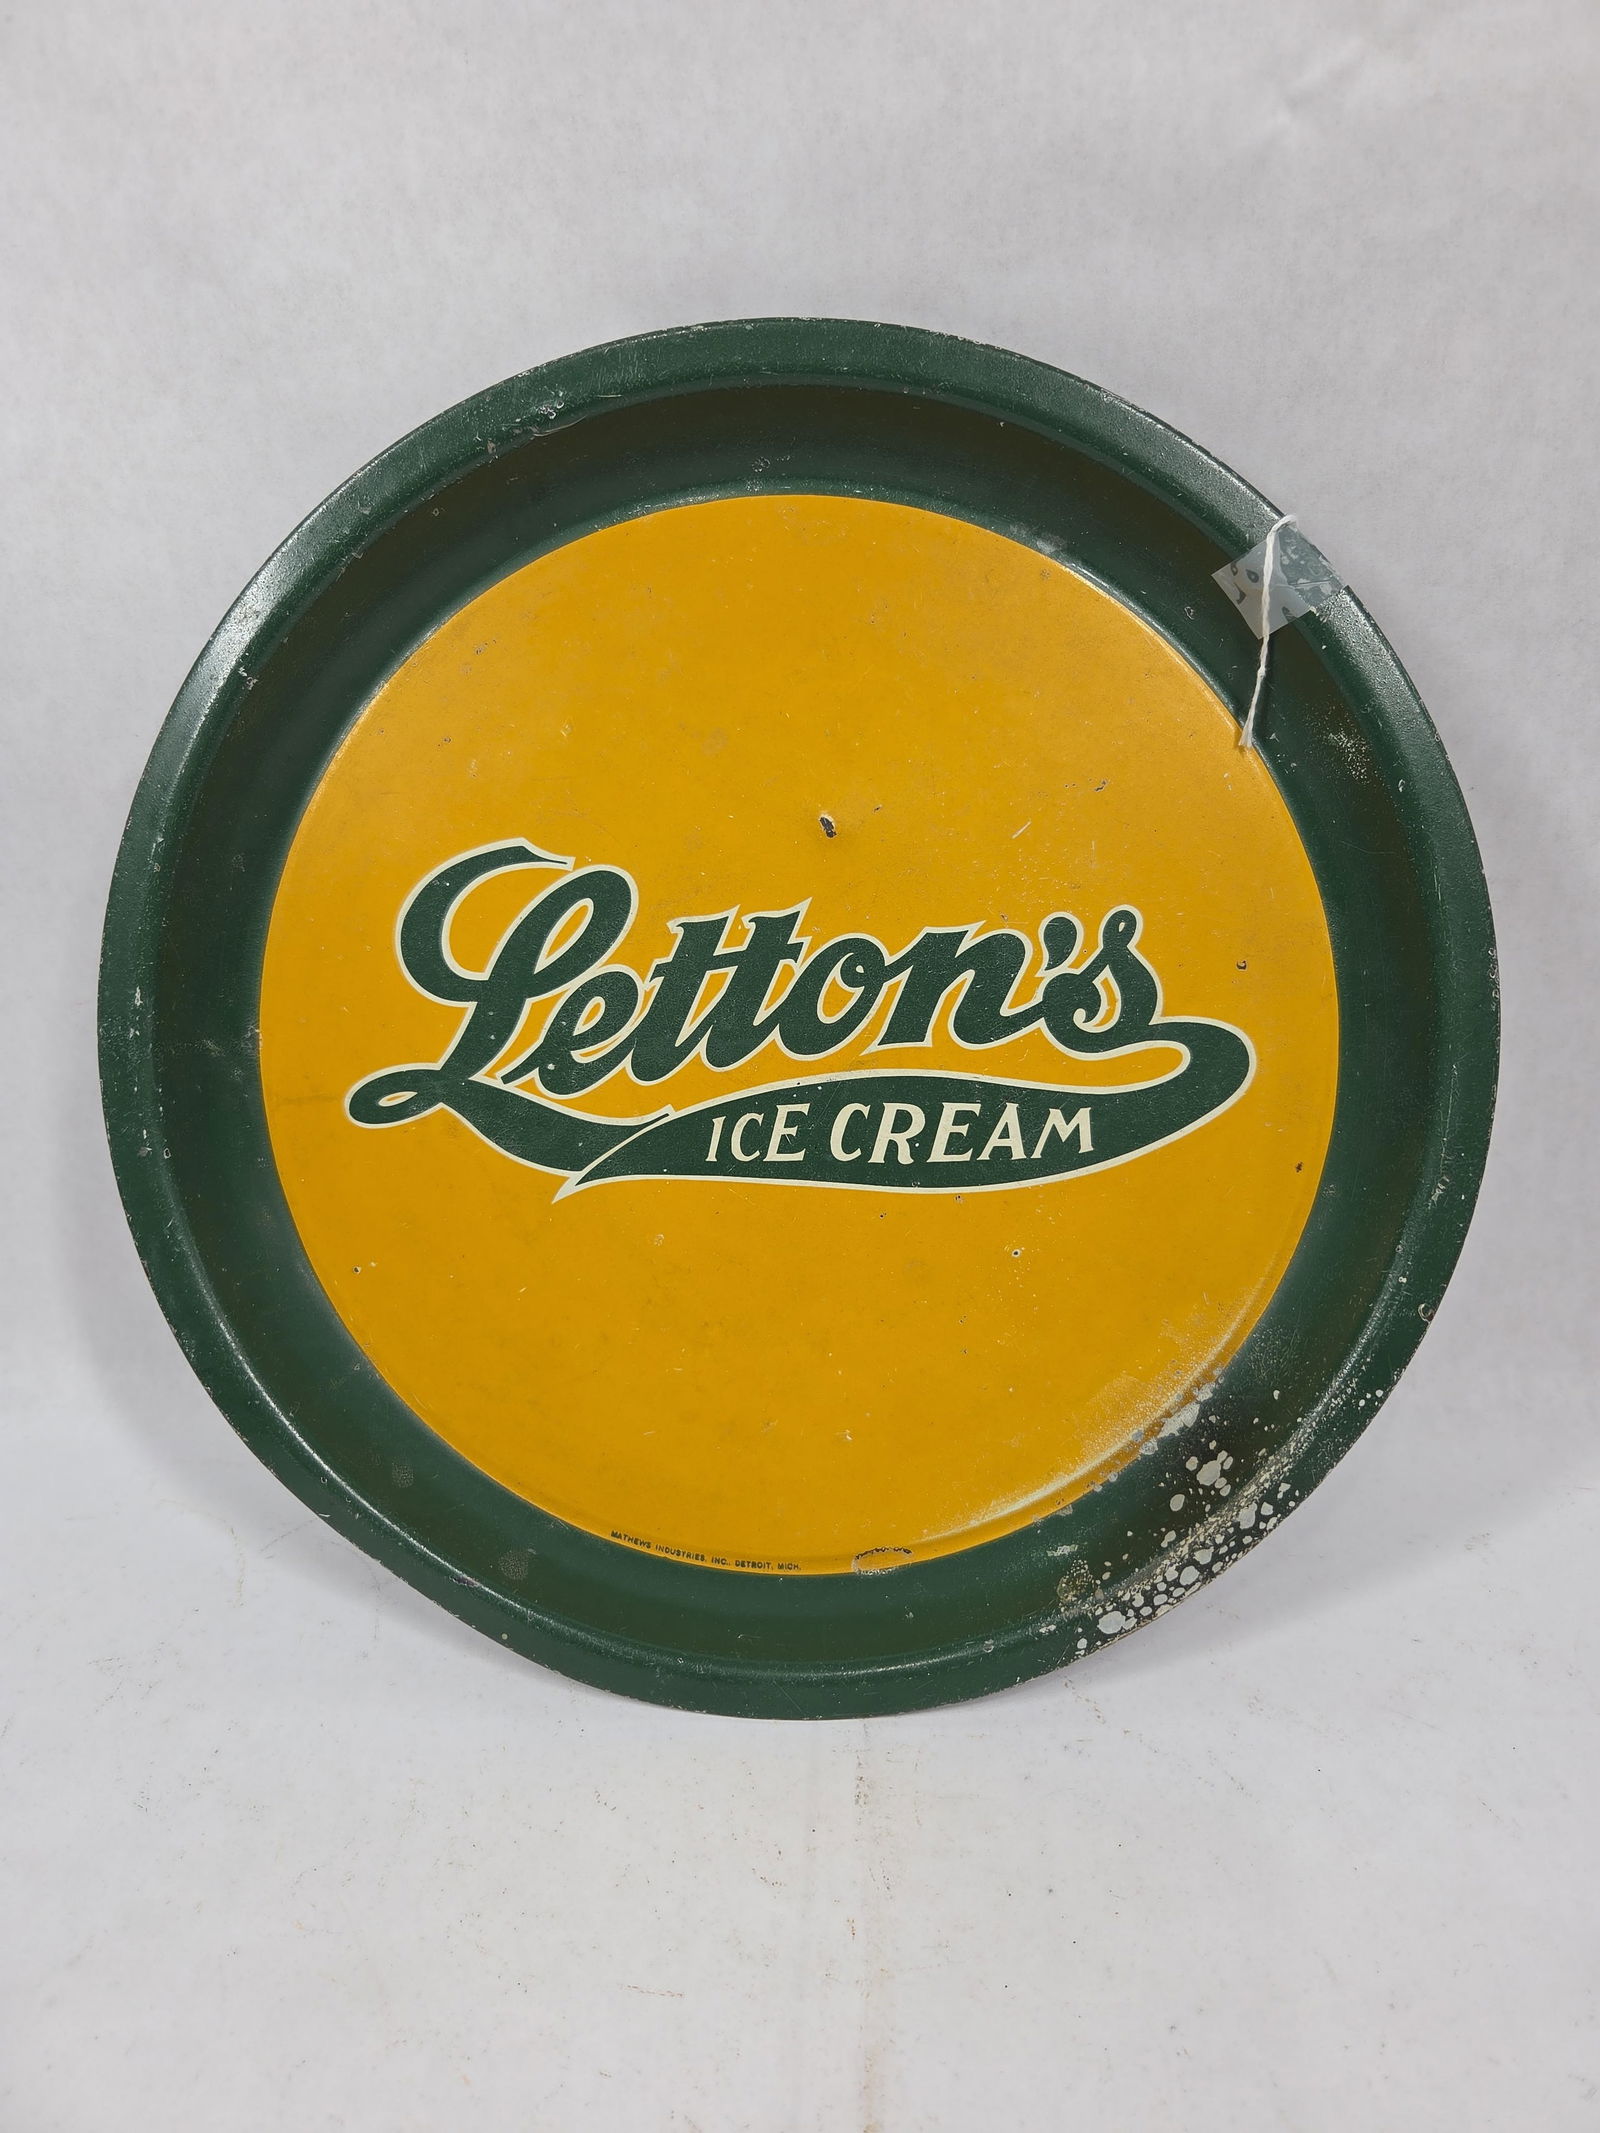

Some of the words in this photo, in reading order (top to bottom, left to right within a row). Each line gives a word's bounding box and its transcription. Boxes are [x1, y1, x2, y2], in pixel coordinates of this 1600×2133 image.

[346, 838, 1168, 1130] Letton's
[705, 1102, 811, 1163] ICE
[829, 1102, 1094, 1165] CREAM
[610, 1530, 651, 1549] MATHEWS
[778, 1562, 802, 1571] MICH.
